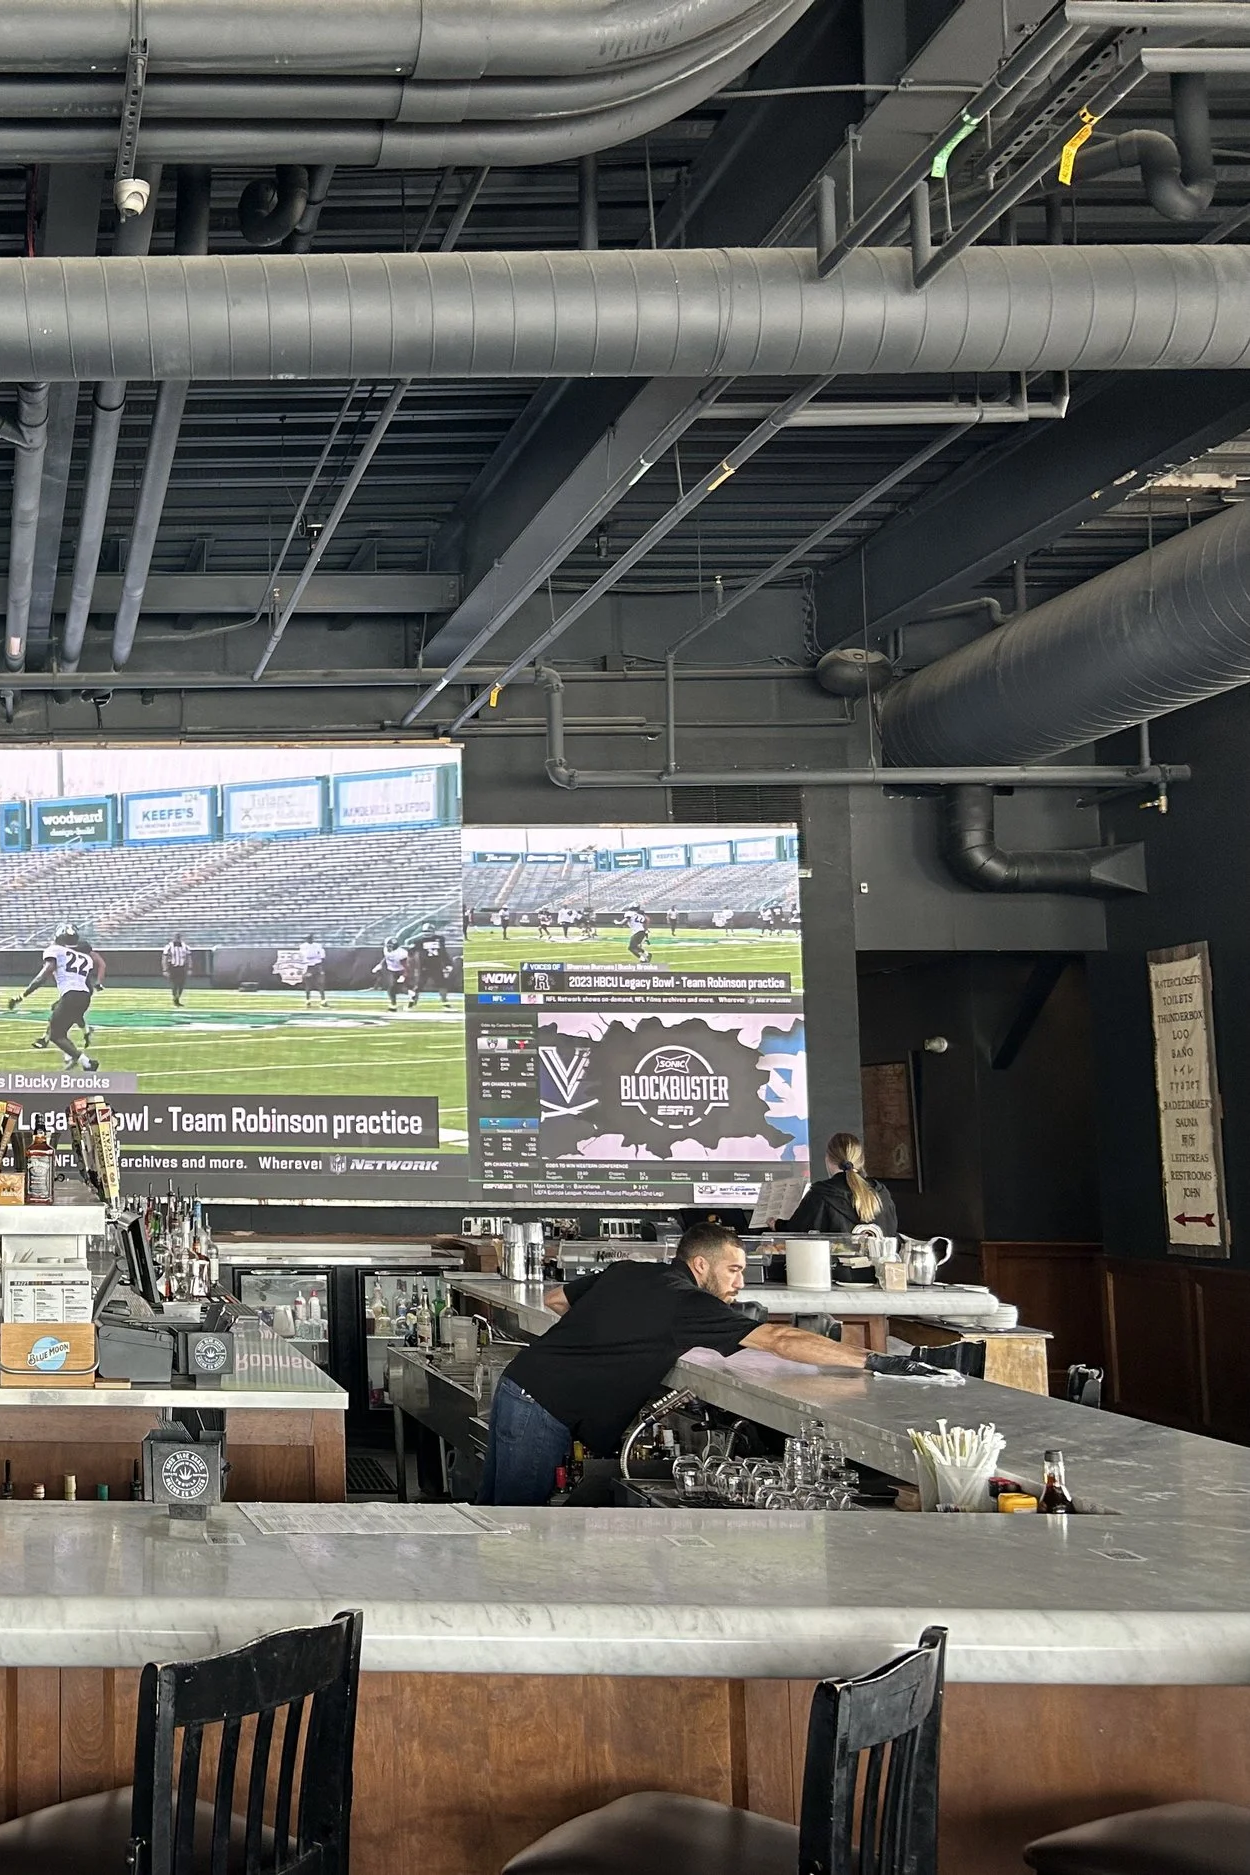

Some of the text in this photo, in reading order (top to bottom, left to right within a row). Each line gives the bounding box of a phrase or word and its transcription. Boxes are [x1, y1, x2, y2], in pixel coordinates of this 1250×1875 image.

[42, 809, 104, 827] woodward
[141, 807, 194, 822] KEEFE'S
[65, 950, 89, 976] 22
[486, 973, 518, 984] NOW
[568, 976, 786, 991] 2023 HBCU Legacy Bowl Team Robinson practice
[1154, 975, 1202, 990] WATERCLOSETS
[1162, 993, 1193, 1006] TOILETS
[1157, 1010, 1203, 1024] THUNDERBOX
[1172, 1029, 1190, 1040] LOO
[1171, 1045, 1194, 1059] BAÑO
[659, 1060, 686, 1068] SONIC
[15, 1075, 57, 1090] Bucky
[61, 1075, 110, 1088] Brooks
[620, 1075, 729, 1101] BLOCKBUSTER
[657, 1105, 694, 1116] ESPN
[1162, 1099, 1211, 1111] BADEZIMMER
[168, 1106, 226, 1132] Team
[232, 1107, 328, 1134] Robinson
[333, 1109, 423, 1139] practice
[1175, 1118, 1199, 1128] SAUNA
[54, 1155, 78, 1168] NFL
[120, 1155, 440, 1171] archives and more. NETWORK
[1171, 1153, 1209, 1163] LEITHREAS
[1170, 1170, 1213, 1181] RESTROOMS
[697, 1185, 718, 1194] XFL
[1183, 1187, 1201, 1200] JOHN
[28, 1343, 69, 1366] BLUE MOON
[190, 1455, 206, 1470] AGAVE
[165, 1477, 180, 1495] HECHO
